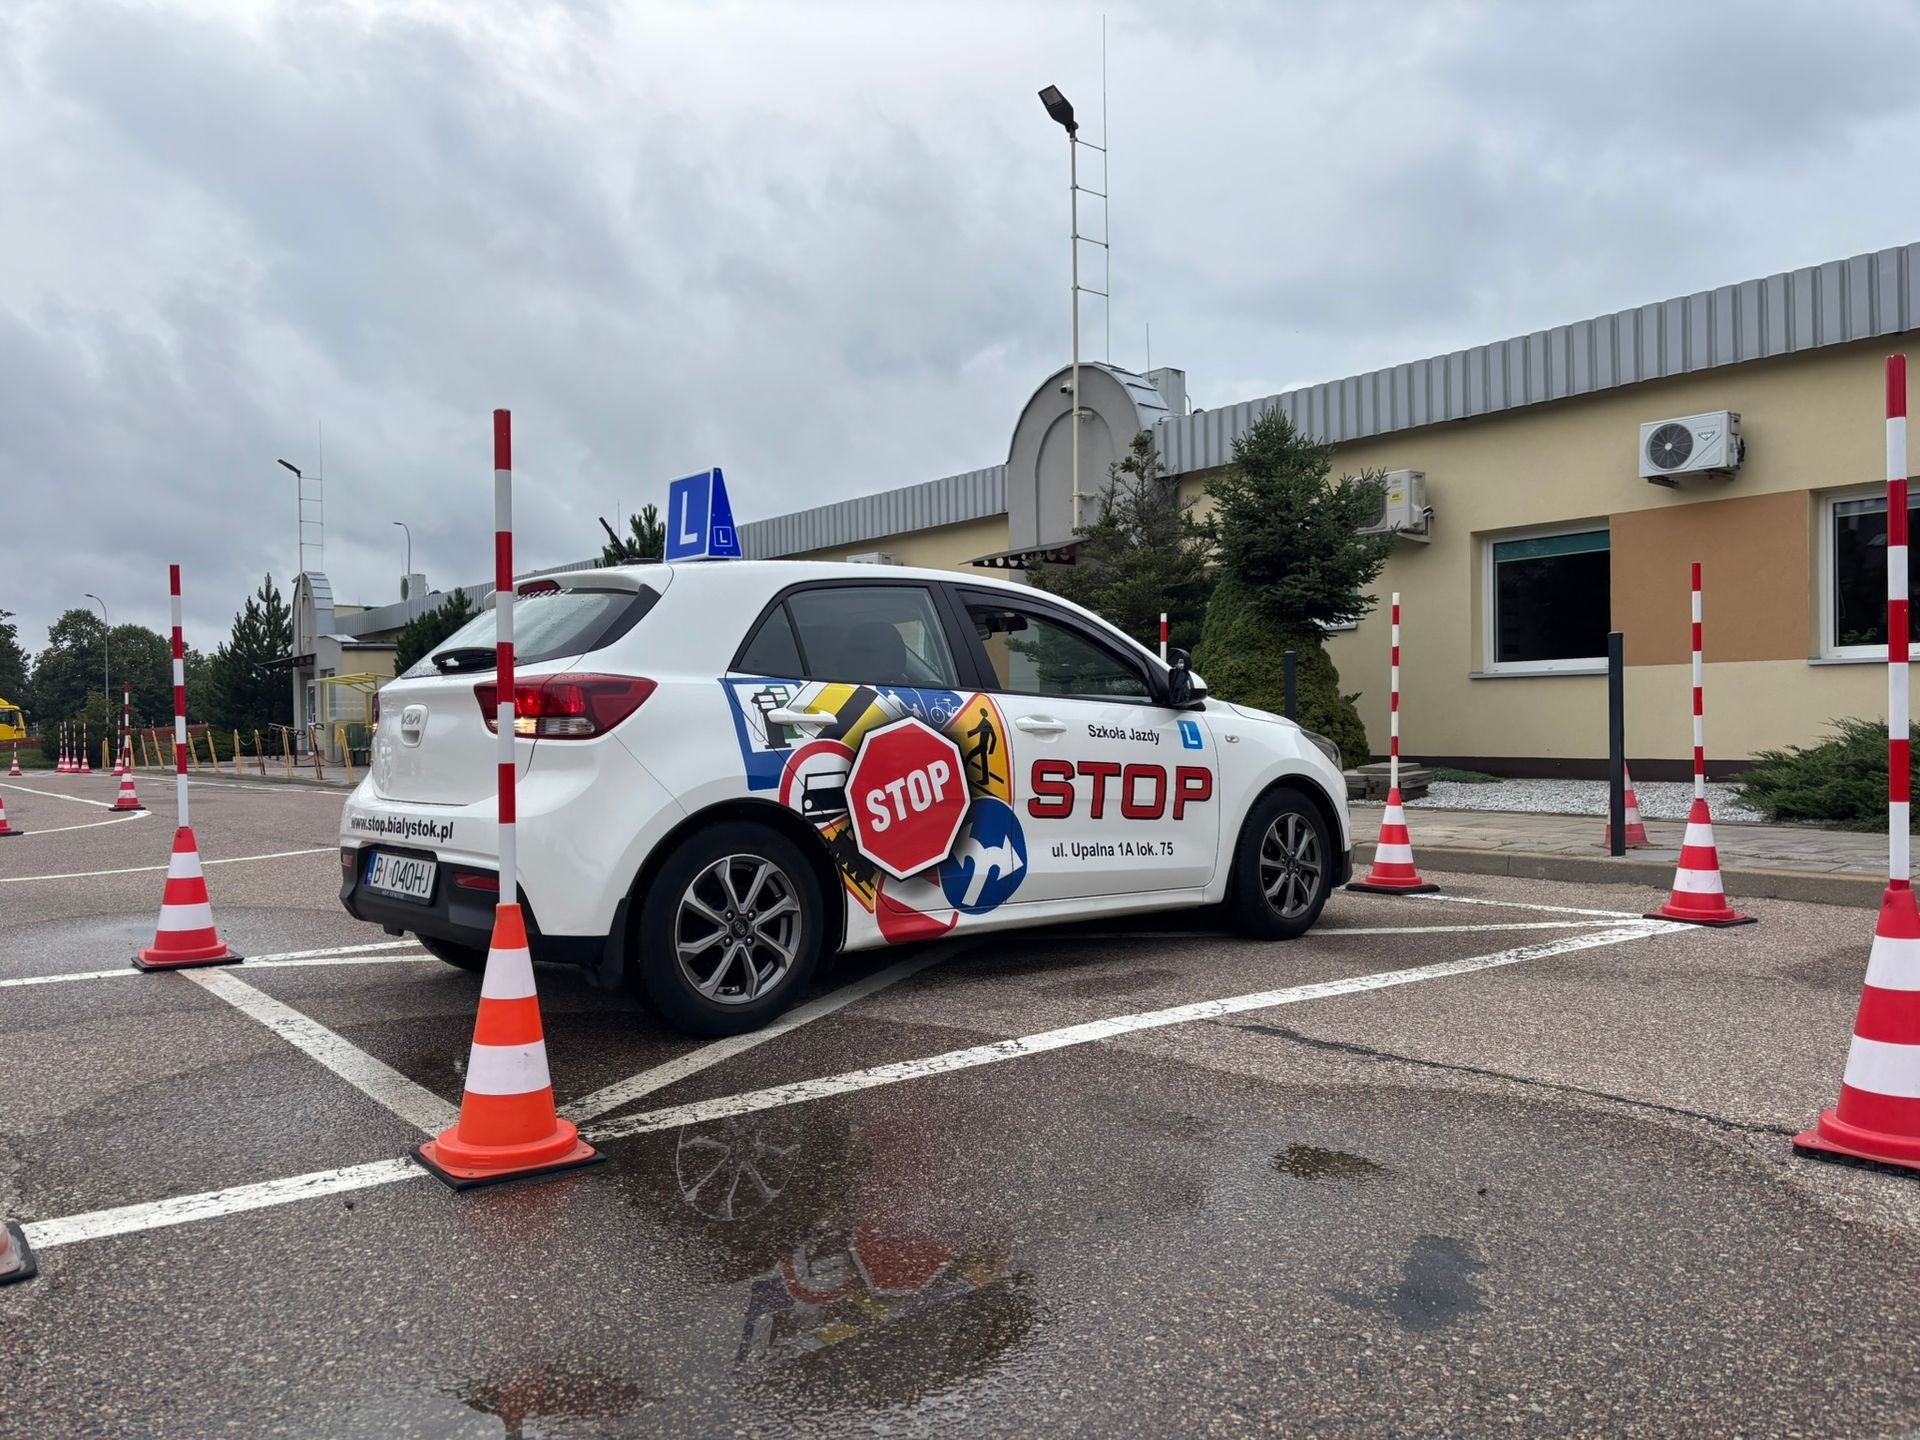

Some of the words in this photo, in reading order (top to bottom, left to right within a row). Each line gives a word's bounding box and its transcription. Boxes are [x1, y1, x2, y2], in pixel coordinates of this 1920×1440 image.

[679, 490, 698, 545] L
[719, 529, 729, 543] L
[1088, 724, 1126, 740] Szkoła
[1129, 728, 1160, 746] Jazdy
[1183, 723, 1199, 745] L
[865, 759, 950, 833] STOP
[1027, 758, 1213, 821] STOP
[351, 815, 454, 843] www.stop.bialystok.pl
[1051, 842, 1068, 857] ul.
[1071, 842, 1115, 861] Upalna
[1118, 841, 1134, 856] 1A
[1136, 841, 1158, 856] lok.
[1159, 841, 1174, 856] 75
